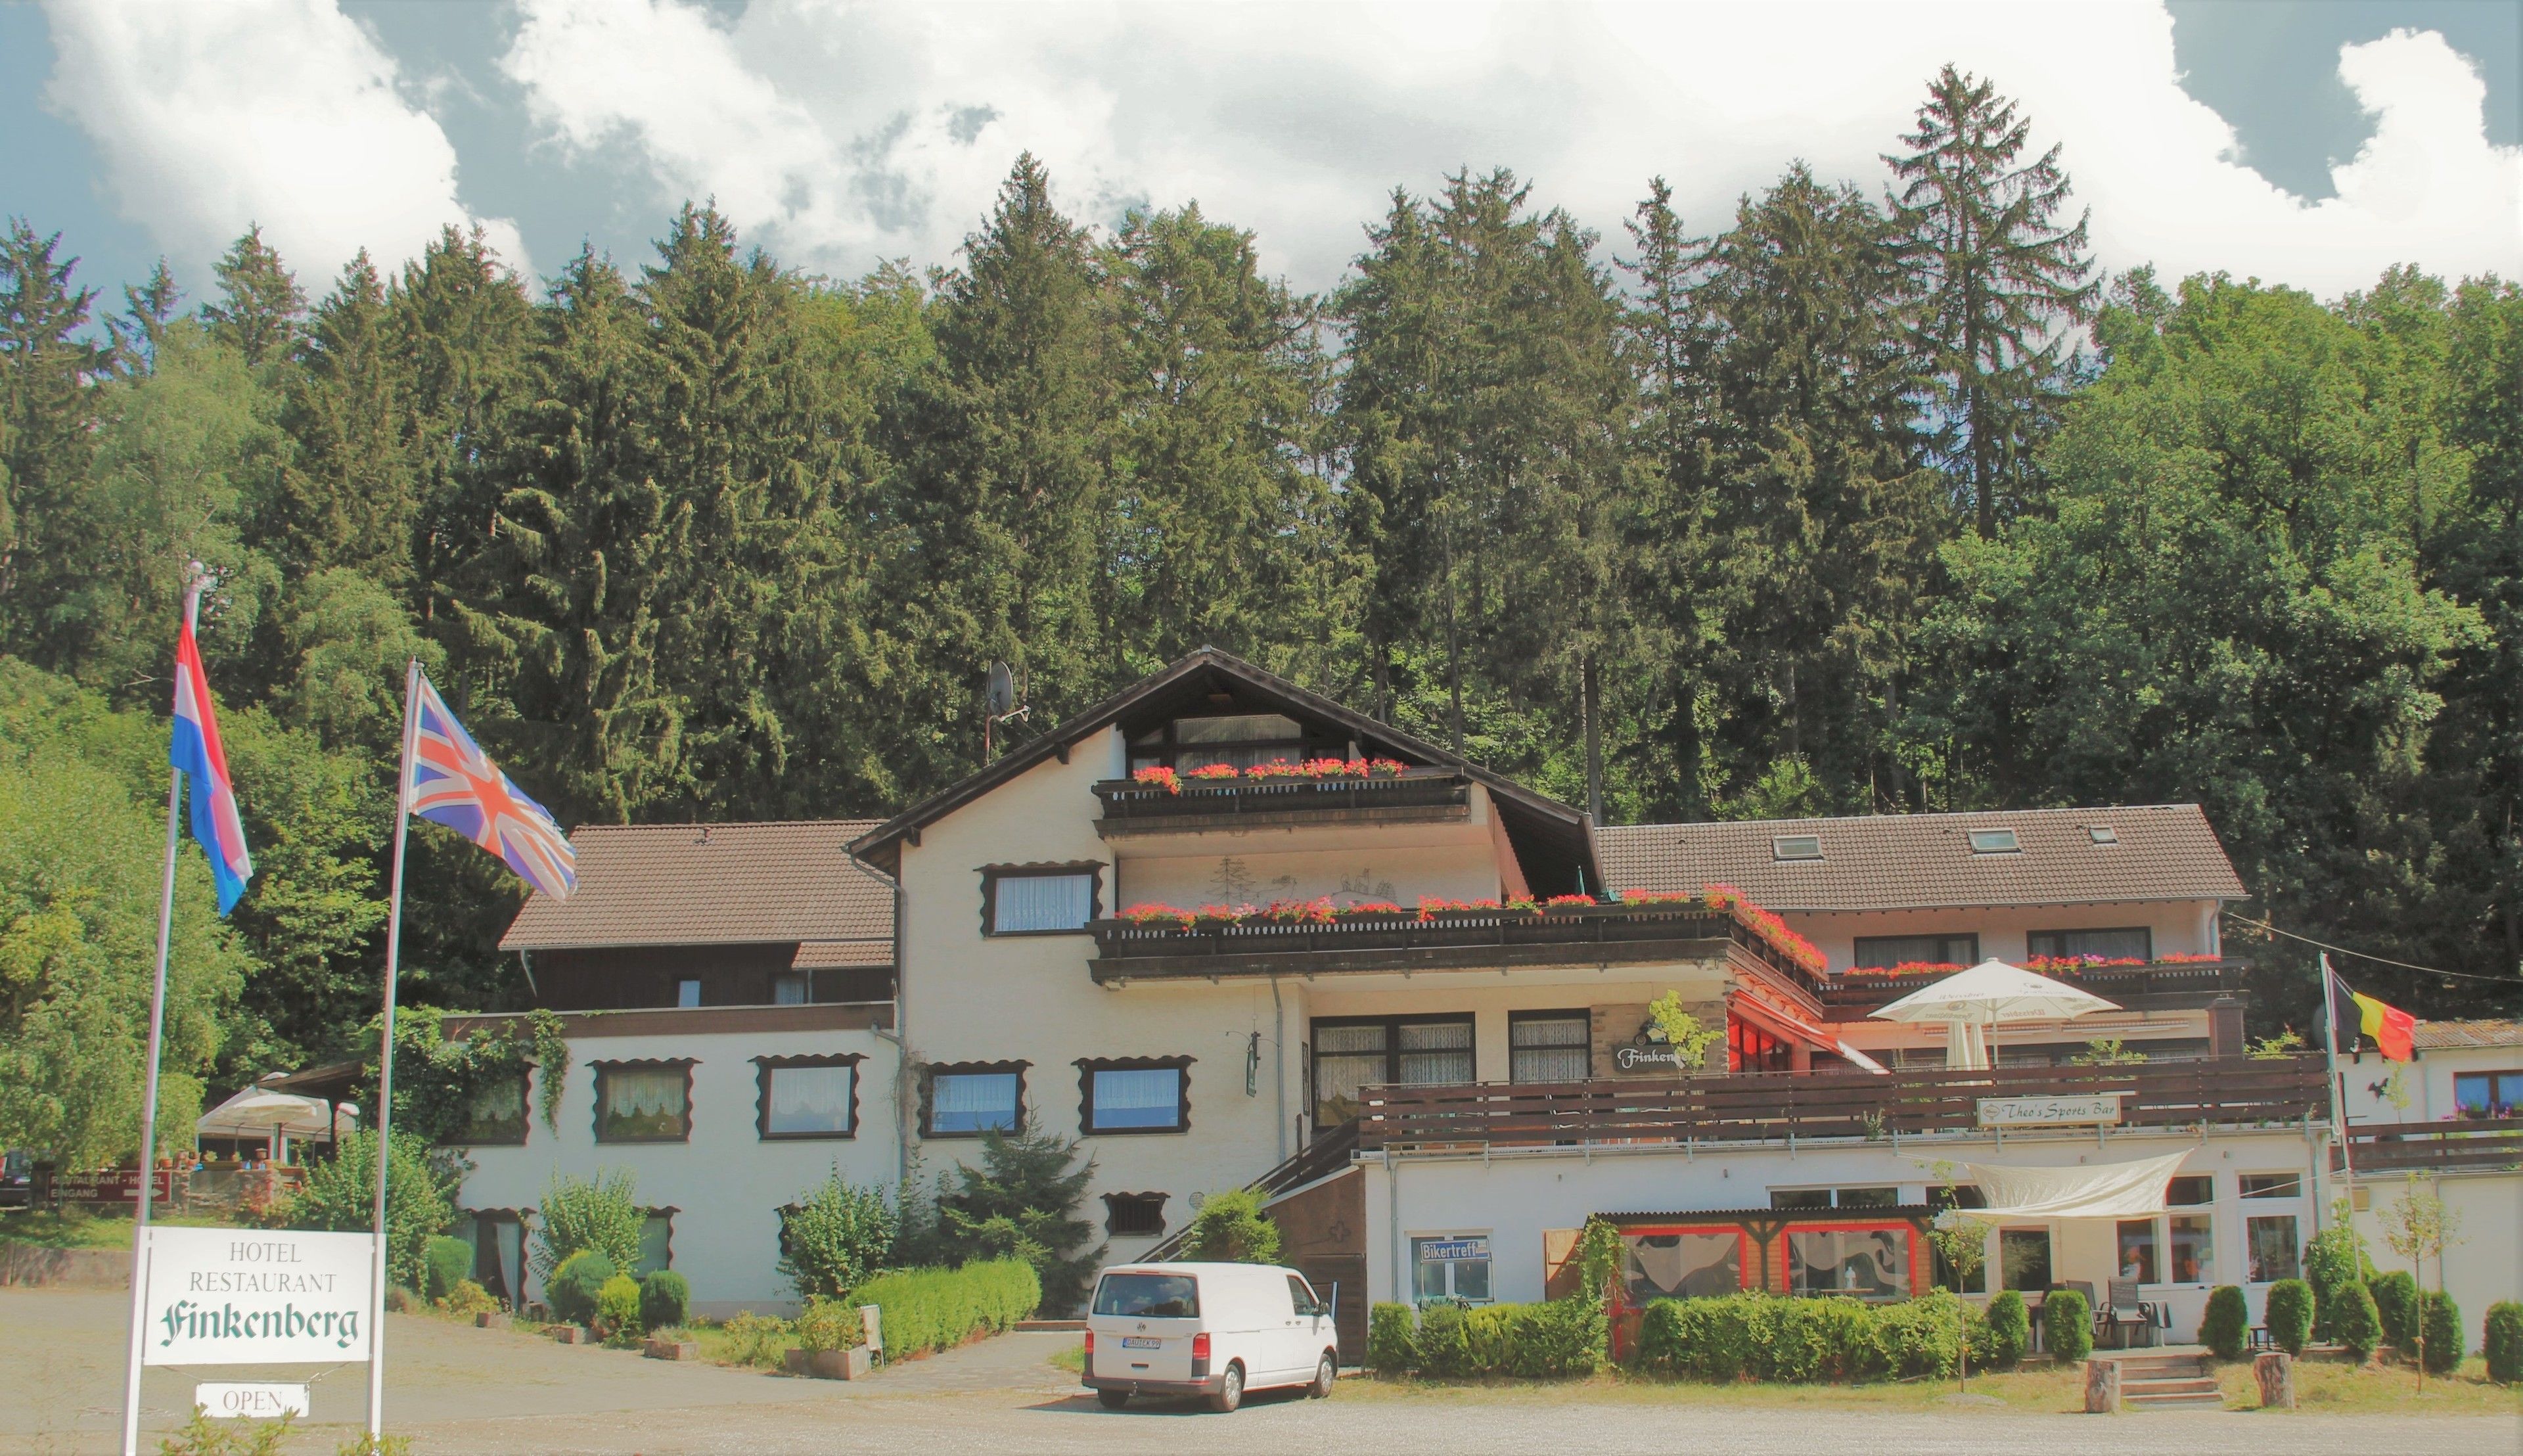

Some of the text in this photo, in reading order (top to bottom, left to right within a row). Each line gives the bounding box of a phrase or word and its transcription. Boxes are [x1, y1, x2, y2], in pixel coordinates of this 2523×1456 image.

[2002, 1104, 2041, 1118] Theo's
[2043, 1103, 2086, 1120] Sports
[2092, 1102, 2114, 1114] Bar
[229, 1242, 302, 1263] HOTEL
[1422, 1242, 1477, 1259] Bikertreff
[189, 1271, 337, 1293] RESTAURANT
[160, 1299, 359, 1349] Finkenberg
[223, 1390, 283, 1411] OPEN
